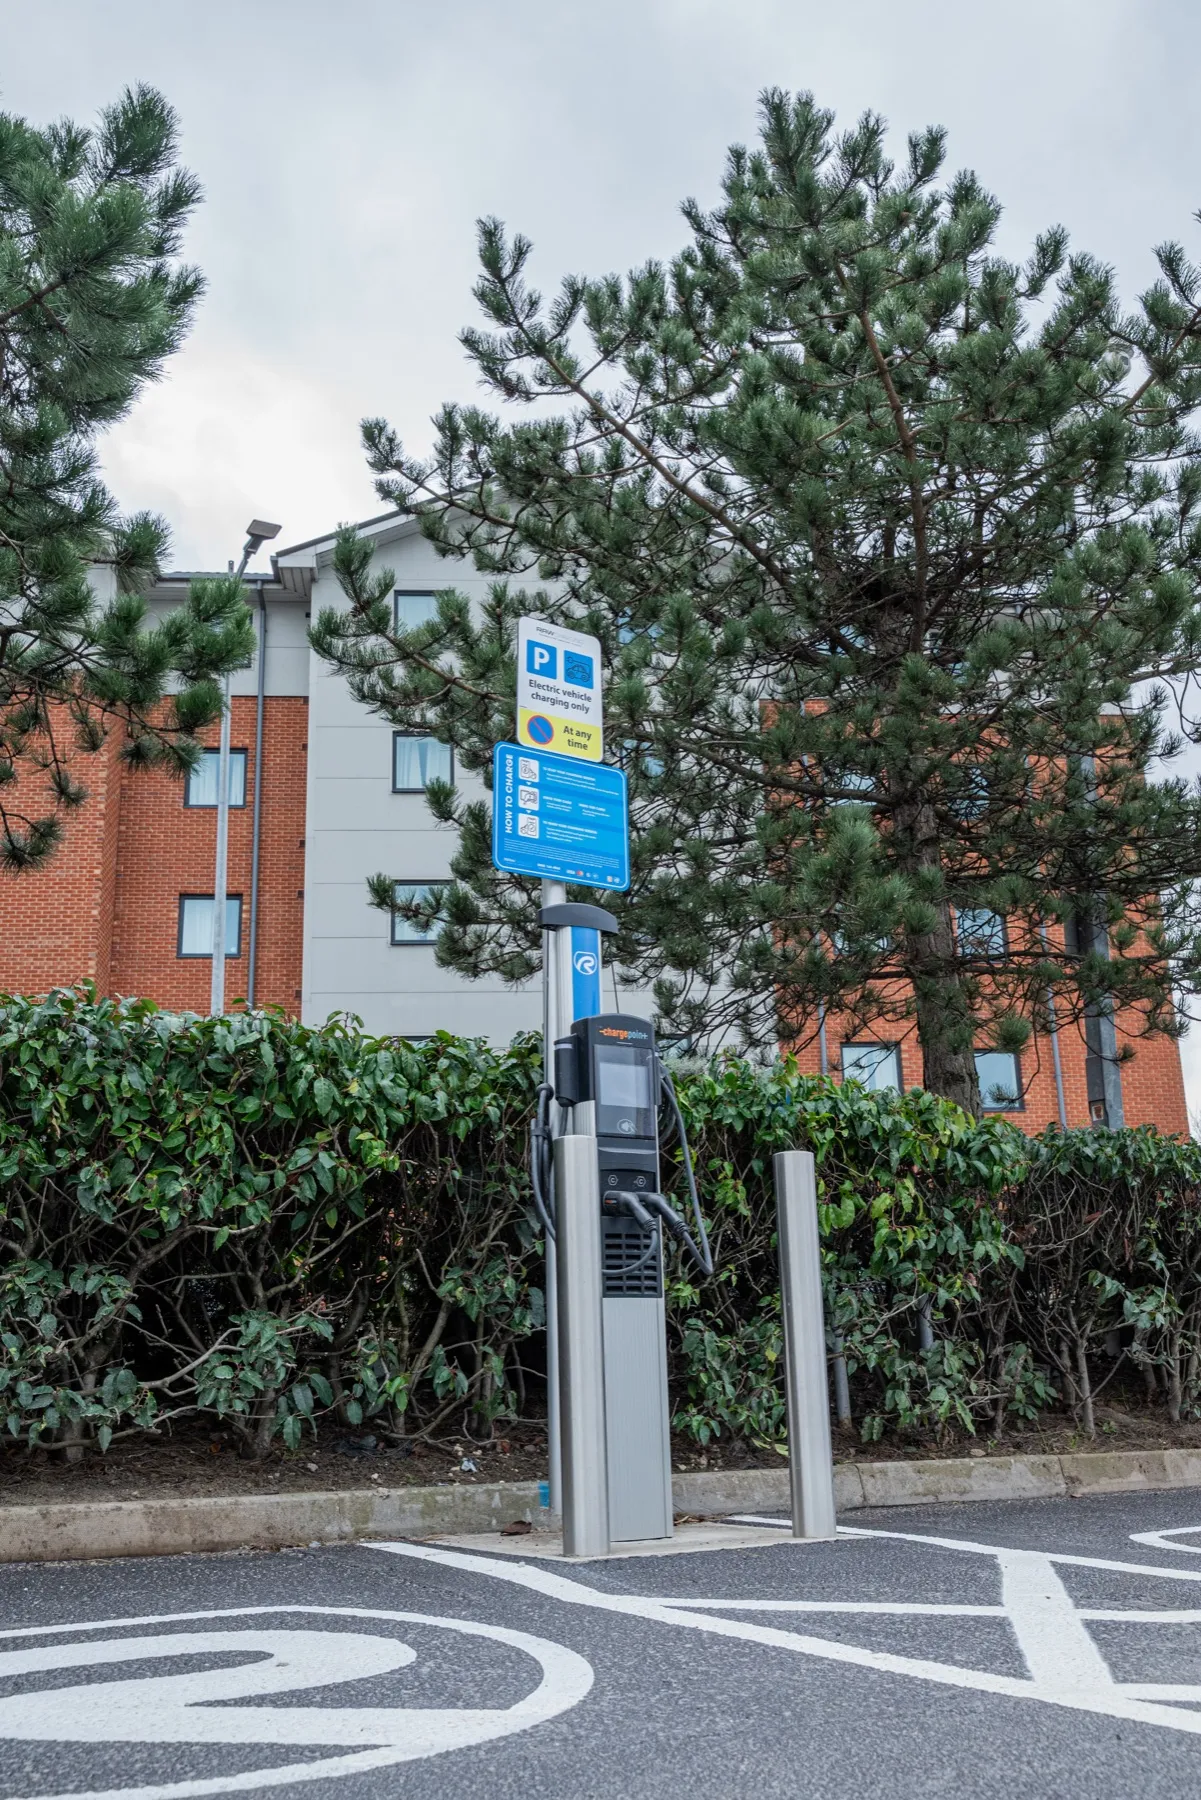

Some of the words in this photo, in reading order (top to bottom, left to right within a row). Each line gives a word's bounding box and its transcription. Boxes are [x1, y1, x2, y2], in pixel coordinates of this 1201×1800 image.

[534, 647, 550, 670] P
[528, 679, 560, 695] Electric
[562, 688, 592, 703] vehicle
[531, 692, 569, 710] charging
[571, 703, 590, 714] only
[563, 726, 574, 736] At
[575, 729, 592, 741] any
[567, 739, 588, 750] time
[505, 754, 514, 794] CHARGE
[505, 795, 514, 808] TO
[505, 808, 514, 834] HOW
